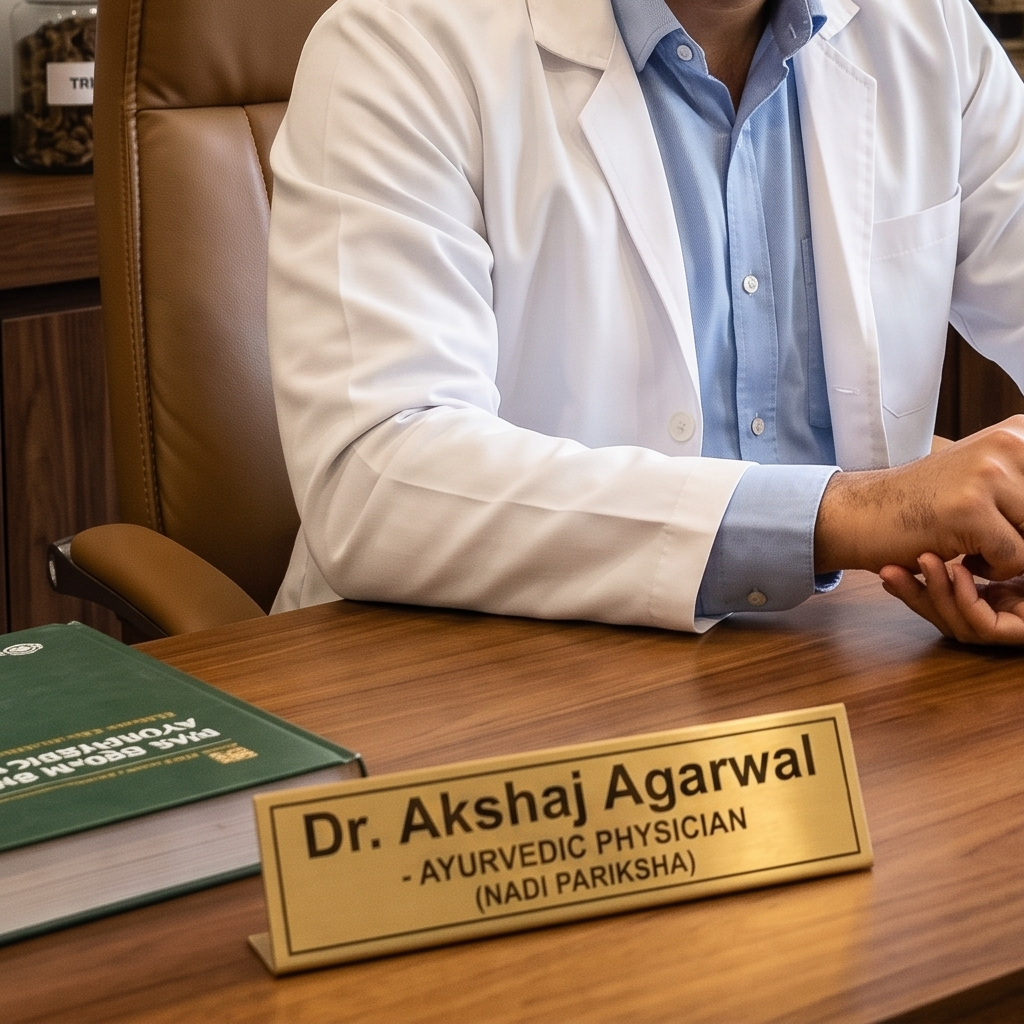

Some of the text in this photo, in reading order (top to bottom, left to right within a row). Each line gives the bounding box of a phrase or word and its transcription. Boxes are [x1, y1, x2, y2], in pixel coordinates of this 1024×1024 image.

[303, 733, 816, 860] Dr. Akshaj Agarwal
[418, 834, 587, 886] AYURVEDIC
[595, 806, 748, 855] PHYSICIAN
[475, 849, 696, 914] (NADI PARIKSHA)
